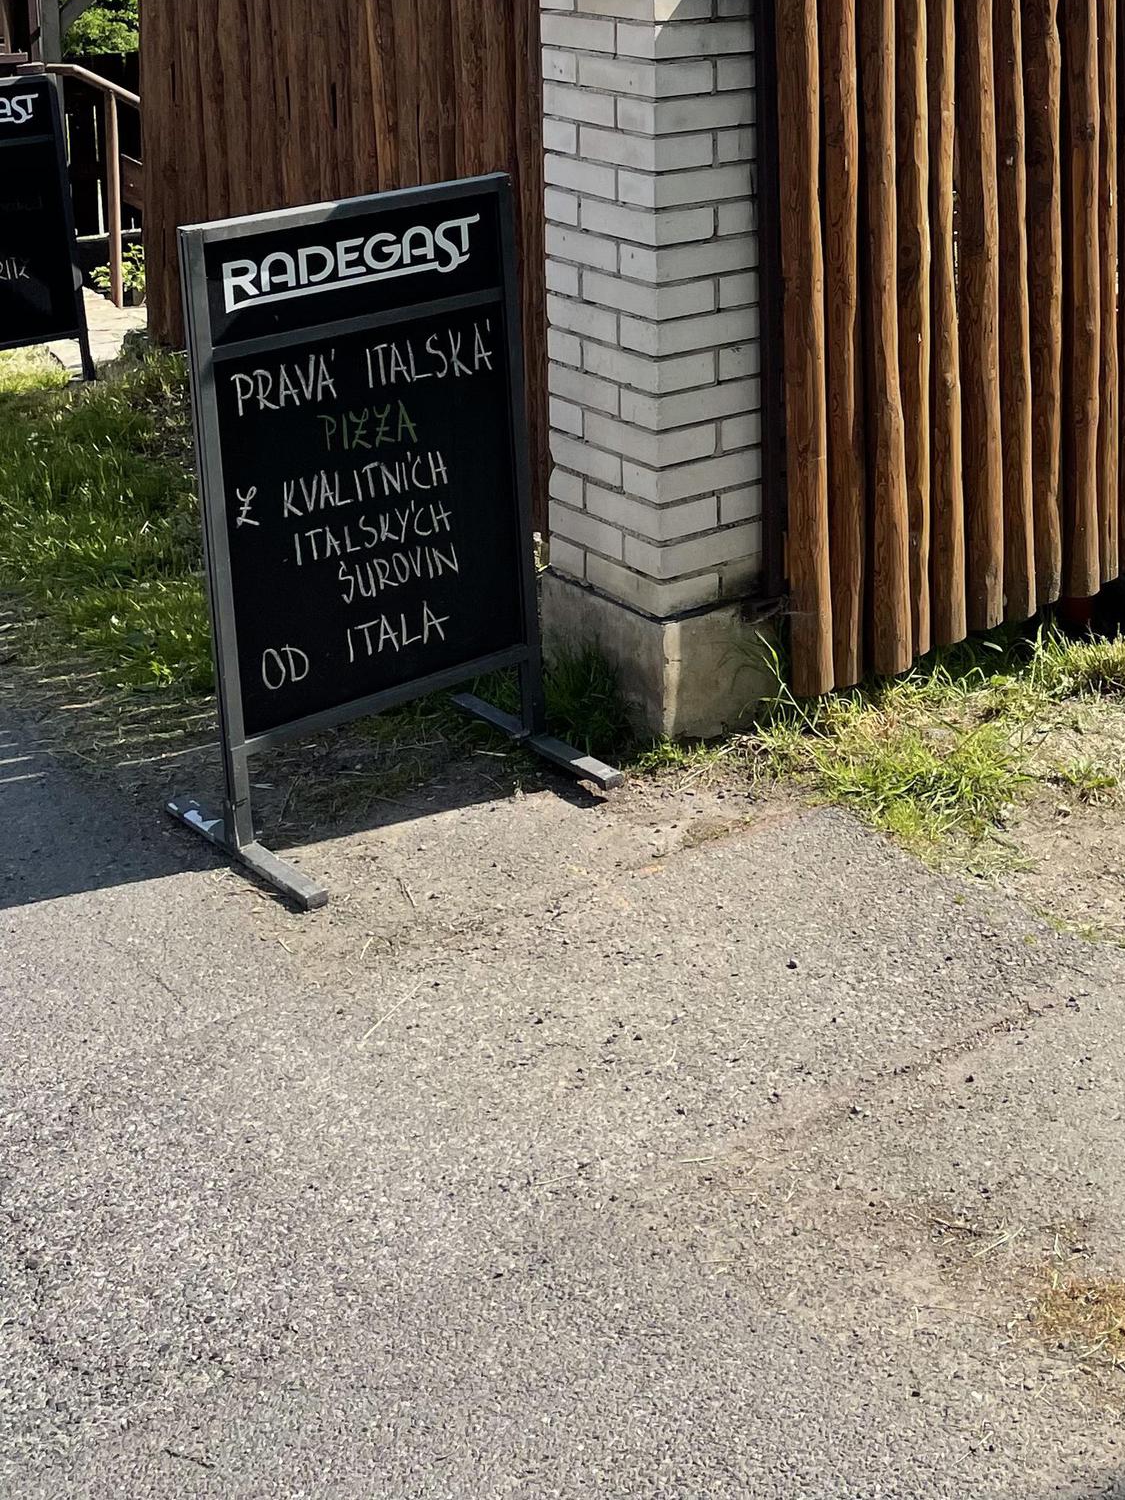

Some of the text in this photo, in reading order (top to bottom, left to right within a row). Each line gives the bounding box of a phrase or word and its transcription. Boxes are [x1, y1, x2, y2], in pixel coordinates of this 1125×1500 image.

[222, 213, 480, 313] RADEGAST
[230, 318, 493, 417] PRAVÁ ITALSKÁ
[316, 399, 418, 450] PIZZA
[235, 451, 448, 529] Z KVALITNÍCH
[294, 500, 452, 566] ITALSKÝCH
[338, 542, 459, 604] SUROVIN
[262, 600, 450, 690] OD ITALA
